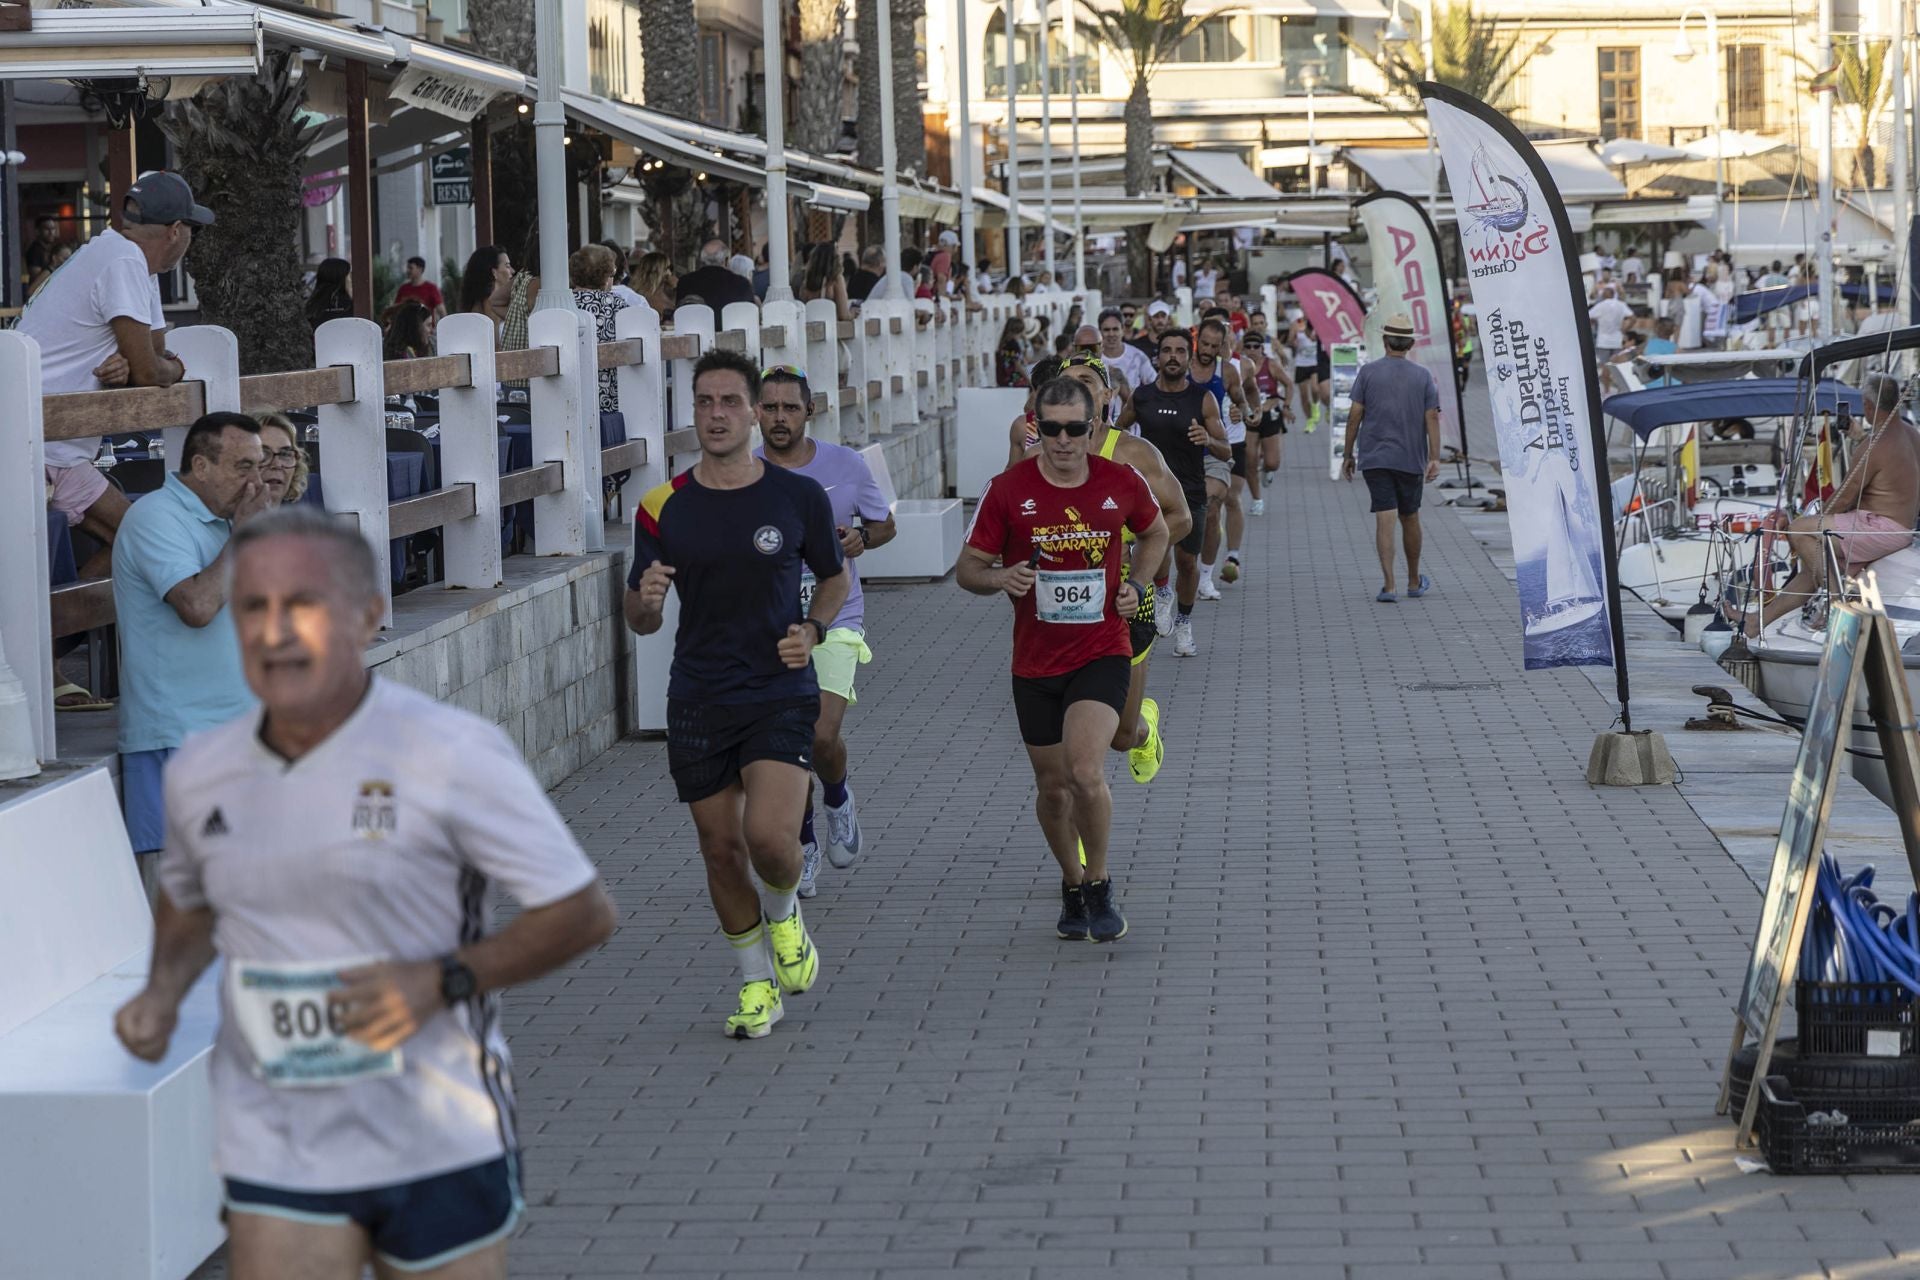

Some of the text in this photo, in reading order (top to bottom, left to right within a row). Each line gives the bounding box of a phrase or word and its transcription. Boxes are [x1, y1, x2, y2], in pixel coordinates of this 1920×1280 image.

[1031, 530, 1112, 543] MADRID
[1054, 585, 1092, 603] 964
[1062, 604, 1085, 612] ROCKY
